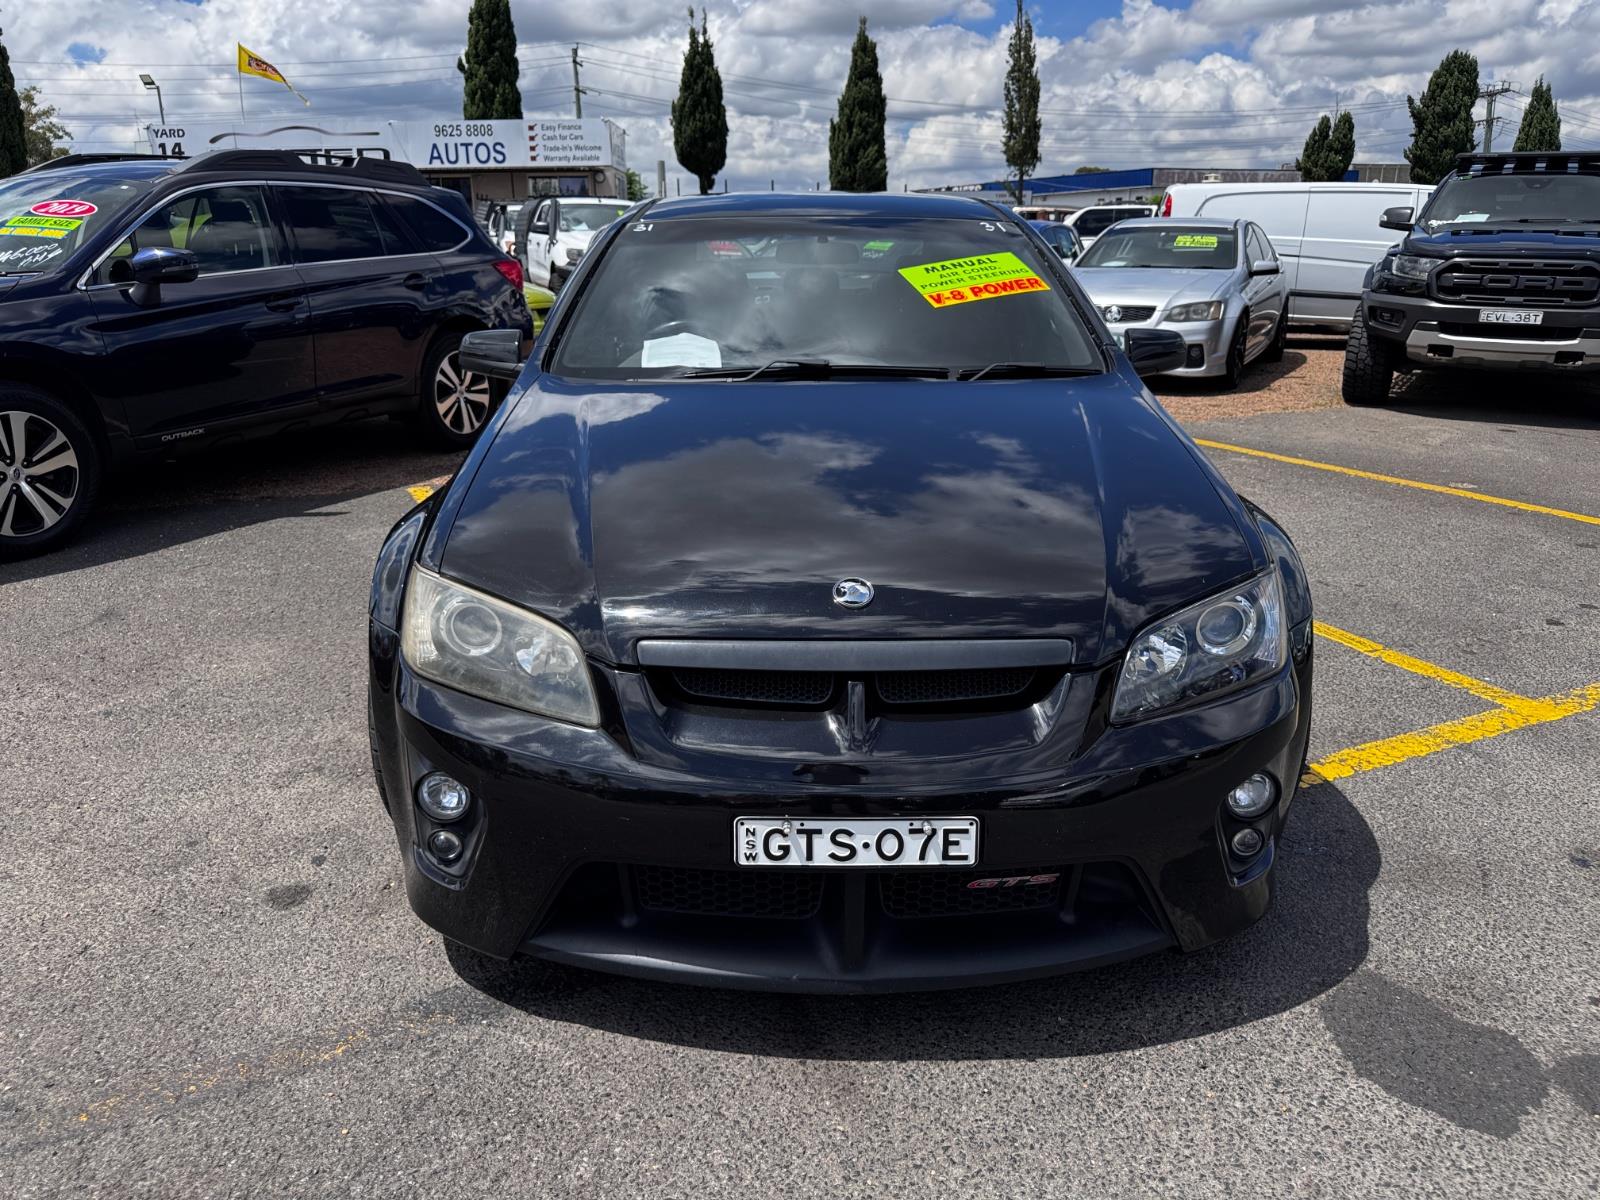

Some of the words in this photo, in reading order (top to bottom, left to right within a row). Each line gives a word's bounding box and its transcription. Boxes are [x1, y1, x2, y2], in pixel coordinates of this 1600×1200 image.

[153, 128, 185, 139] YARD
[434, 124, 462, 137] 9625
[465, 123, 494, 137] 8808
[541, 124, 555, 133] Easy
[557, 123, 582, 131] Finance
[541, 133, 557, 141] Cash
[558, 133, 567, 141] for
[568, 133, 584, 141] Cars
[158, 142, 185, 158] 14
[429, 142, 507, 165] AUTOS
[574, 143, 602, 152] Welcome
[543, 154, 571, 163] Warranty
[572, 153, 600, 162] Available
[37, 202, 90, 214] 2019
[15, 217, 48, 226] FAMILY
[49, 218, 76, 227] SIZE
[980, 222, 1007, 232] 31
[924, 256, 998, 274] MANUAL
[939, 270, 958, 279] AIR
[960, 265, 1002, 275] COND.
[920, 277, 965, 290] POWER
[968, 267, 1029, 282] STEERING
[1440, 272, 1600, 291] FORD
[928, 289, 966, 305] V-8
[969, 277, 1043, 298] POWER
[161, 428, 205, 442] OUTBACK
[967, 873, 1061, 889] GTS
